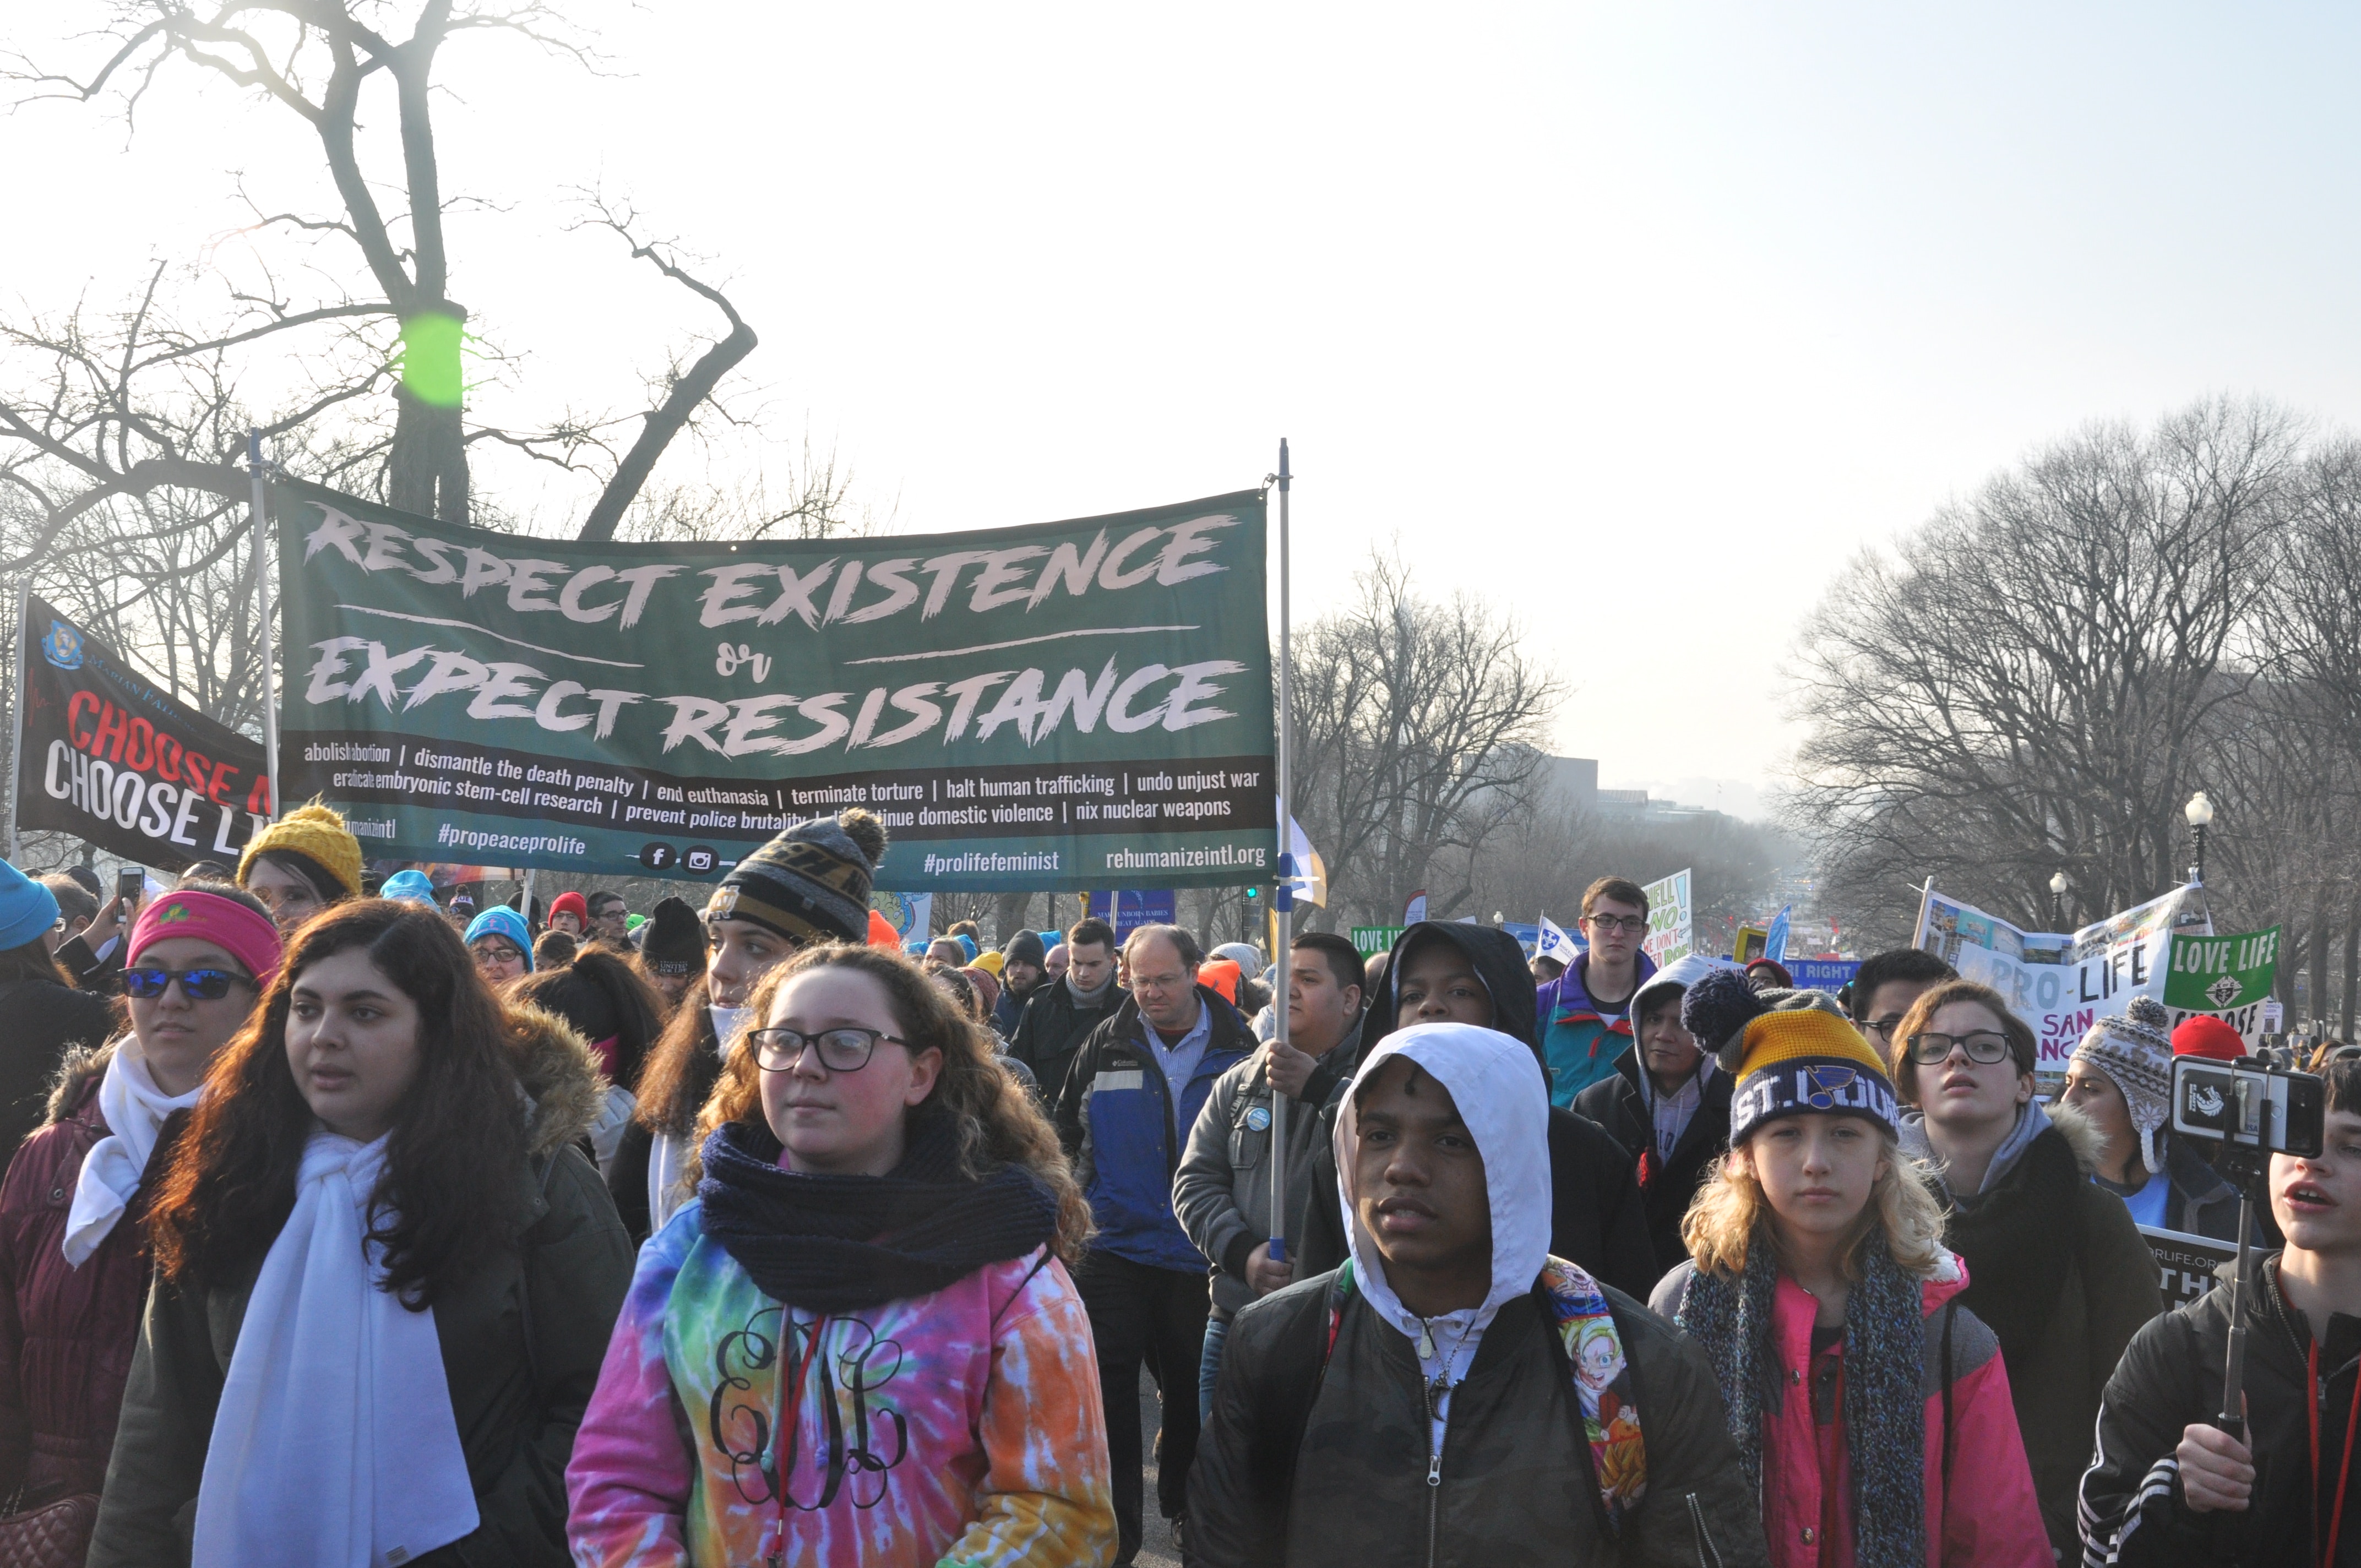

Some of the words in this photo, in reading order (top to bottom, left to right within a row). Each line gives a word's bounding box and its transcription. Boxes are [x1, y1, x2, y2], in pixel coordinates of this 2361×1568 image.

[303, 500, 690, 632] RESPECT
[696, 514, 1243, 632] EXISTENCE
[715, 641, 771, 683] or
[303, 636, 650, 742] EXPECT
[654, 652, 1252, 761] RESISTANCE
[68, 690, 240, 807] CHOOSE
[45, 739, 205, 846] CHOOSE
[304, 742, 351, 761] abolish
[351, 742, 391, 763] abortion
[415, 748, 492, 776] dismantle
[497, 759, 522, 781] the
[526, 763, 571, 787] death
[575, 772, 634, 798] penalty
[657, 785, 684, 803] end
[688, 787, 769, 807] euthanasia
[791, 784, 867, 805] terminate
[871, 782, 923, 802] torture
[946, 778, 975, 799] halt
[980, 777, 1031, 798] human
[1035, 774, 1115, 798] trafficking
[1138, 772, 1173, 792] undo
[1177, 770, 1226, 793] unjust
[1231, 771, 1260, 788] war
[376, 770, 451, 797] embryonic
[455, 780, 530, 806] stem-cell
[534, 791, 602, 815] research
[625, 804, 686, 825] prevent
[689, 807, 738, 829] police
[741, 810, 807, 830] brutality
[918, 804, 987, 826] domestic
[991, 803, 1054, 824] violence
[1076, 801, 1098, 820] nix
[1103, 798, 1159, 819] nuclear
[1163, 798, 1231, 820] weapons
[438, 823, 586, 856] #propeaceprolife
[923, 850, 1059, 876] #prolifefeminist
[1106, 844, 1266, 869] rehumanizeintl.org
[1646, 878, 1674, 911] HELL
[1353, 930, 1383, 952] LOVE
[1643, 938, 1653, 954] WE
[1656, 928, 1679, 950] DON'T
[2174, 940, 2232, 974] LOVE
[2237, 931, 2277, 972] LIFE
[1806, 965, 1851, 978] RIGHT
[2041, 1008, 2093, 1038] SAN
[2173, 1004, 2258, 1036] COSE
[2159, 1267, 2223, 1296] TH
